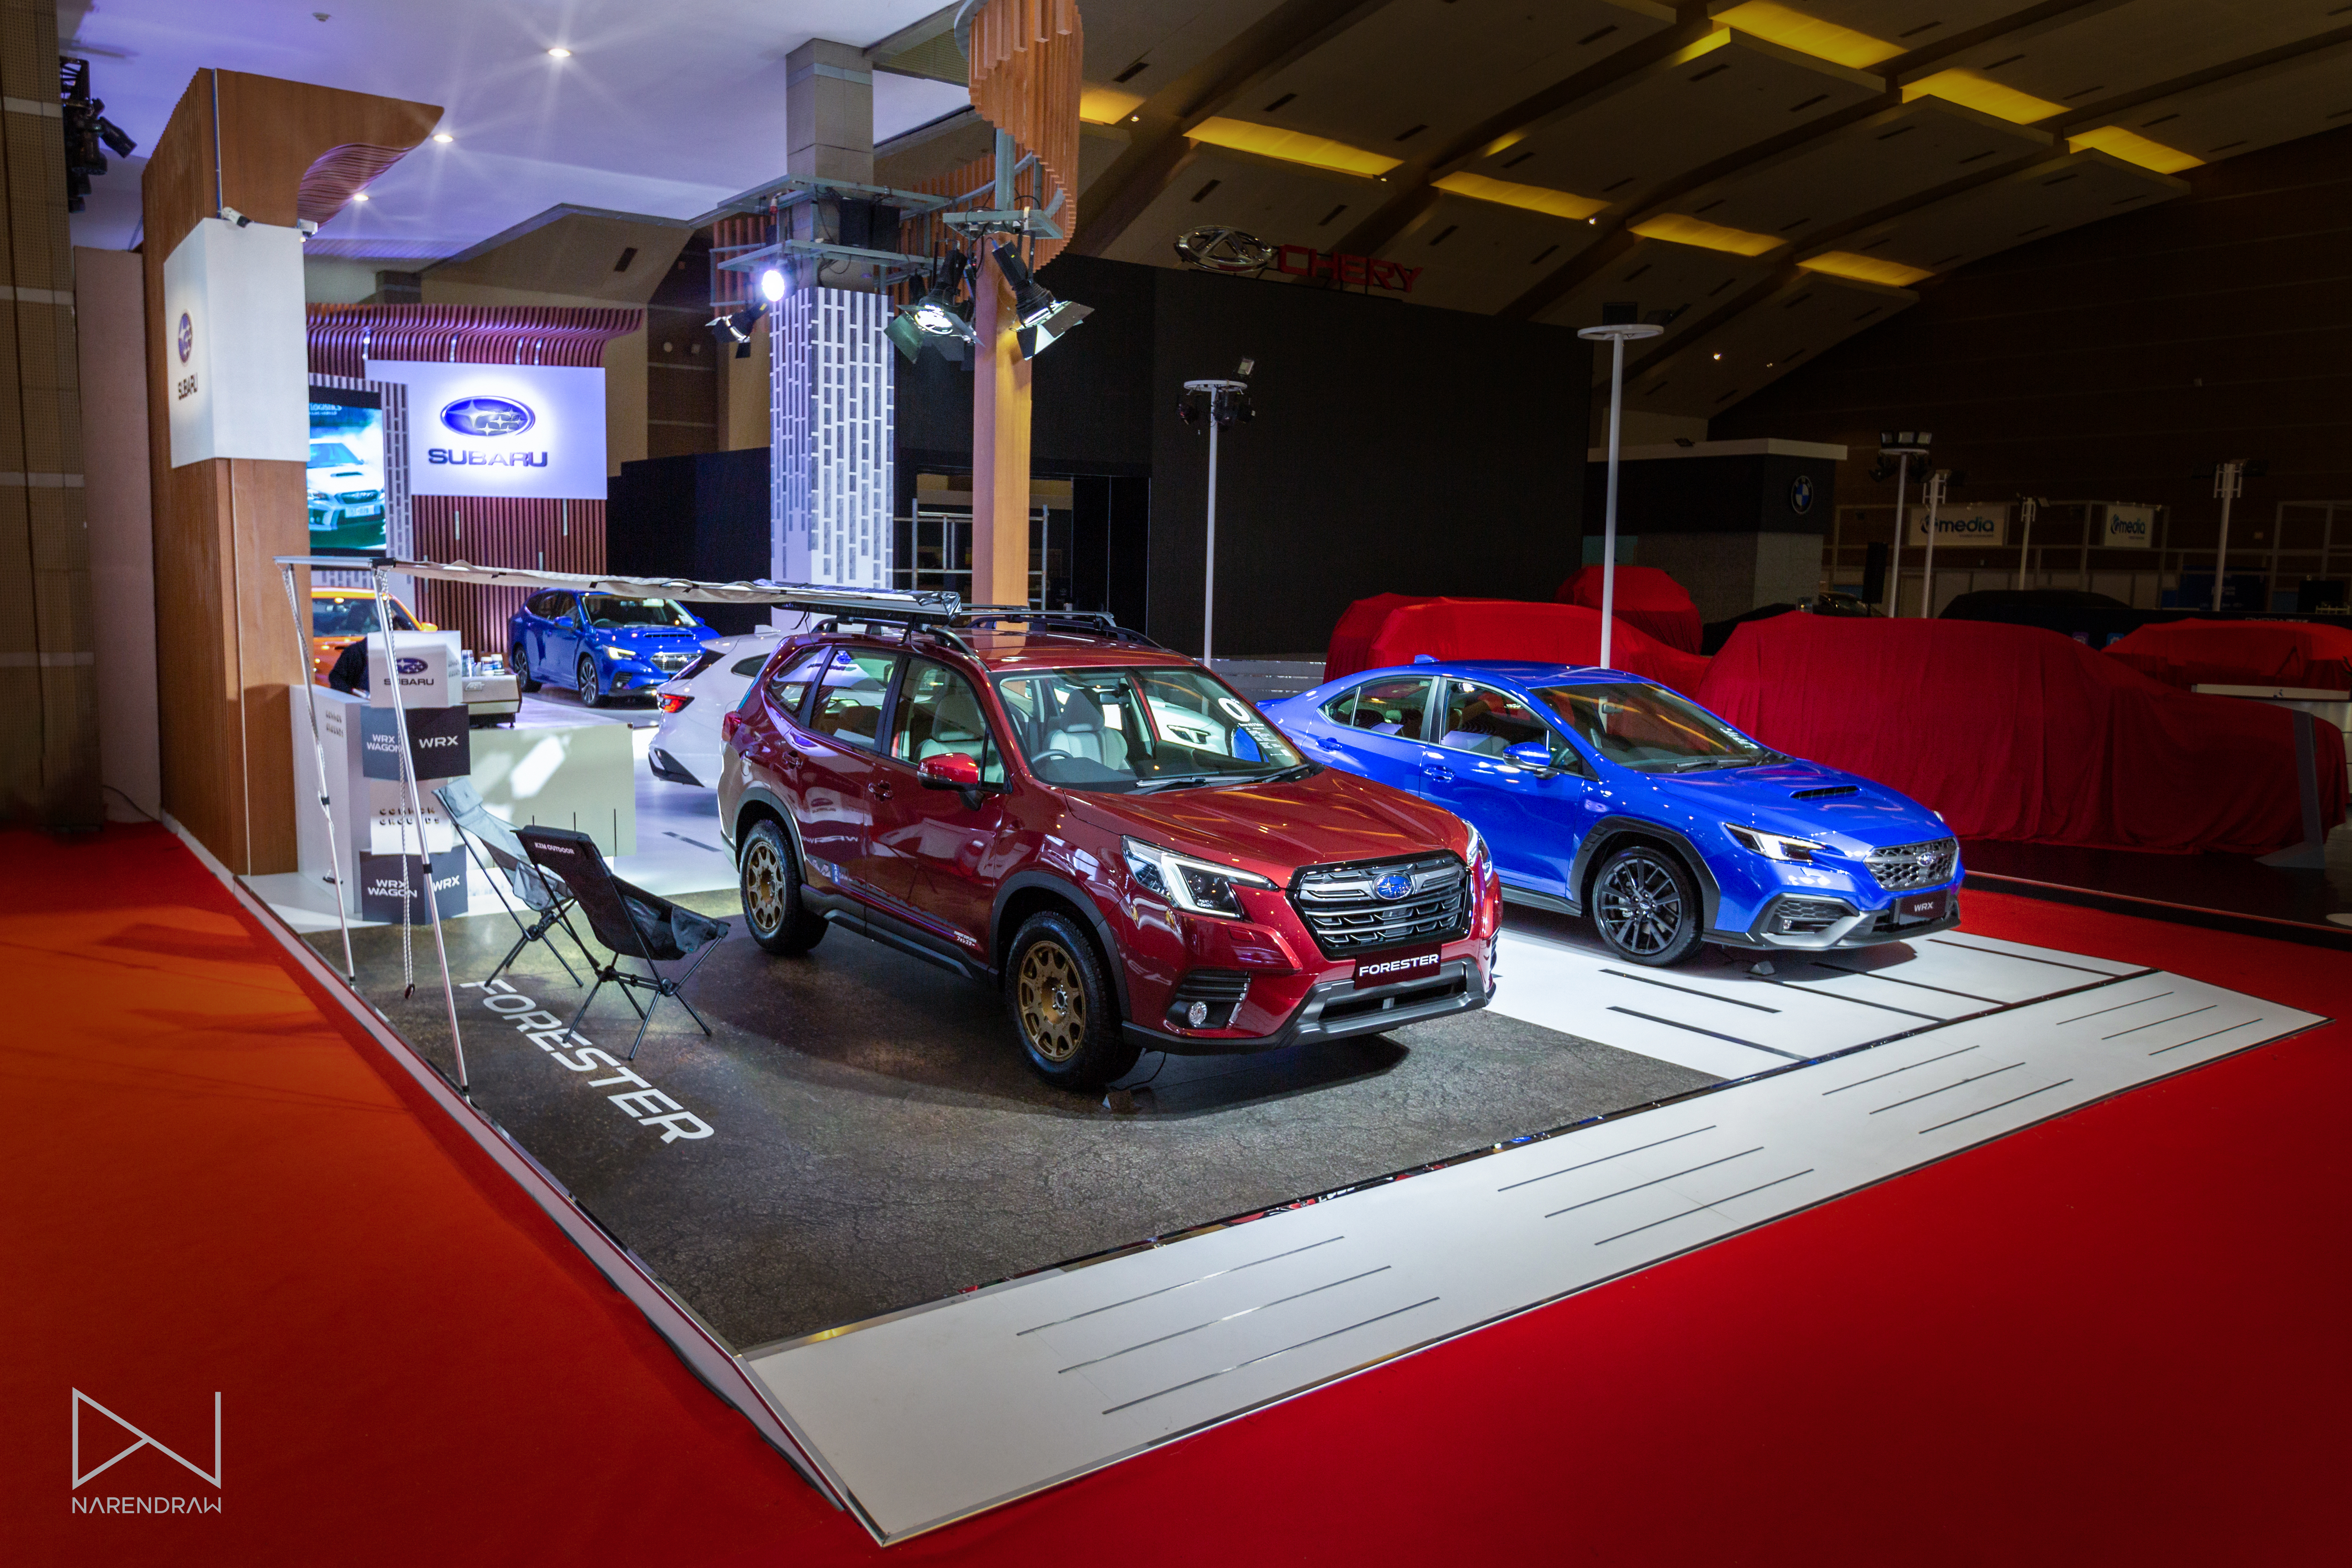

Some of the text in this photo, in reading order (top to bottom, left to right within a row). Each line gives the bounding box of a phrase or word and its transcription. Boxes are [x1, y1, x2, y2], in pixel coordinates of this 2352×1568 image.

[1277, 244, 1424, 293] CHERY
[178, 373, 198, 401] SUBARU
[428, 448, 548, 468] SUBARU
[372, 734, 395, 744] WRX
[419, 735, 459, 749] WRX
[547, 844, 575, 854] OUTDOOR
[376, 879, 407, 889] WRX
[432, 875, 460, 892] WRX
[368, 887, 418, 898] WAGON
[1914, 901, 1933, 913] WRX
[1359, 953, 1439, 977] FORESTER
[459, 979, 714, 1144] FORESTER
